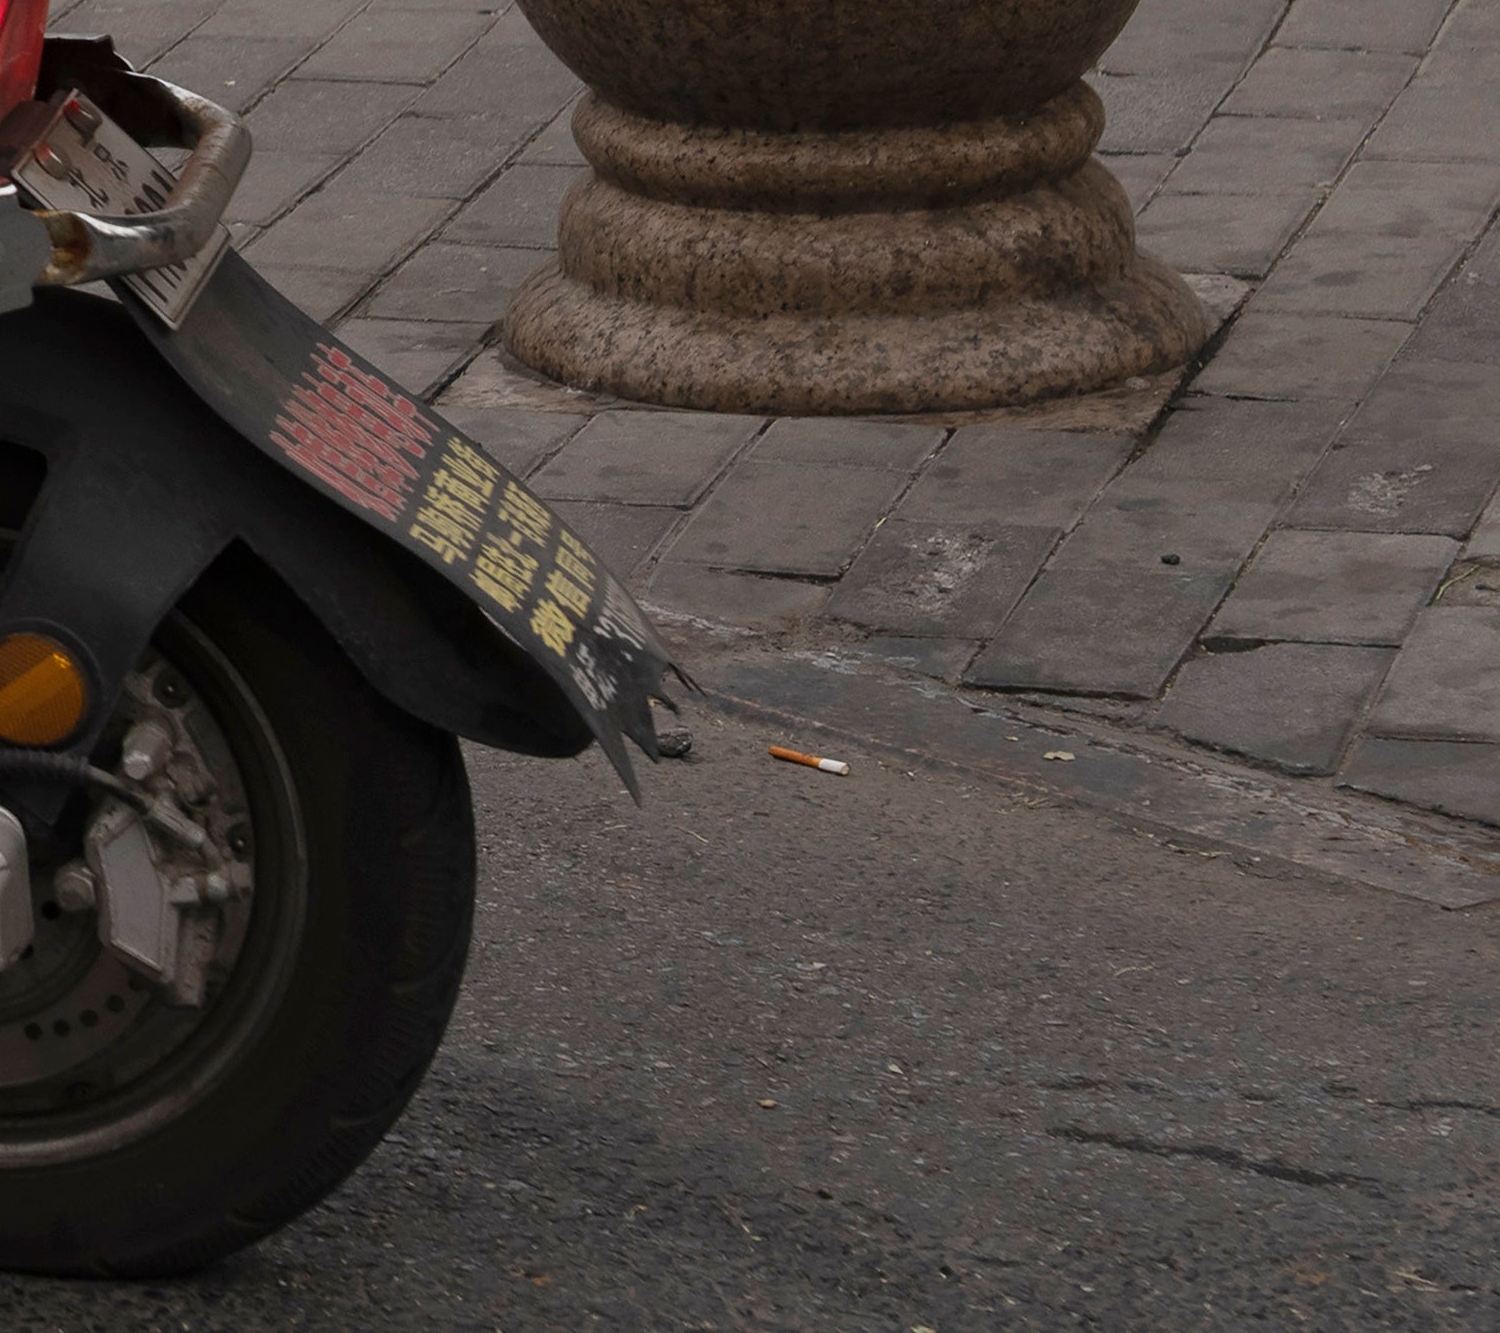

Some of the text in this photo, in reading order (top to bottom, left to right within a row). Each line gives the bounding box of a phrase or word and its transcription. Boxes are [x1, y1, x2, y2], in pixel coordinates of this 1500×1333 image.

[67, 136, 129, 210] 北京
[409, 437, 503, 565] 马驹桥商业街
[529, 530, 599, 657] 微信同号
